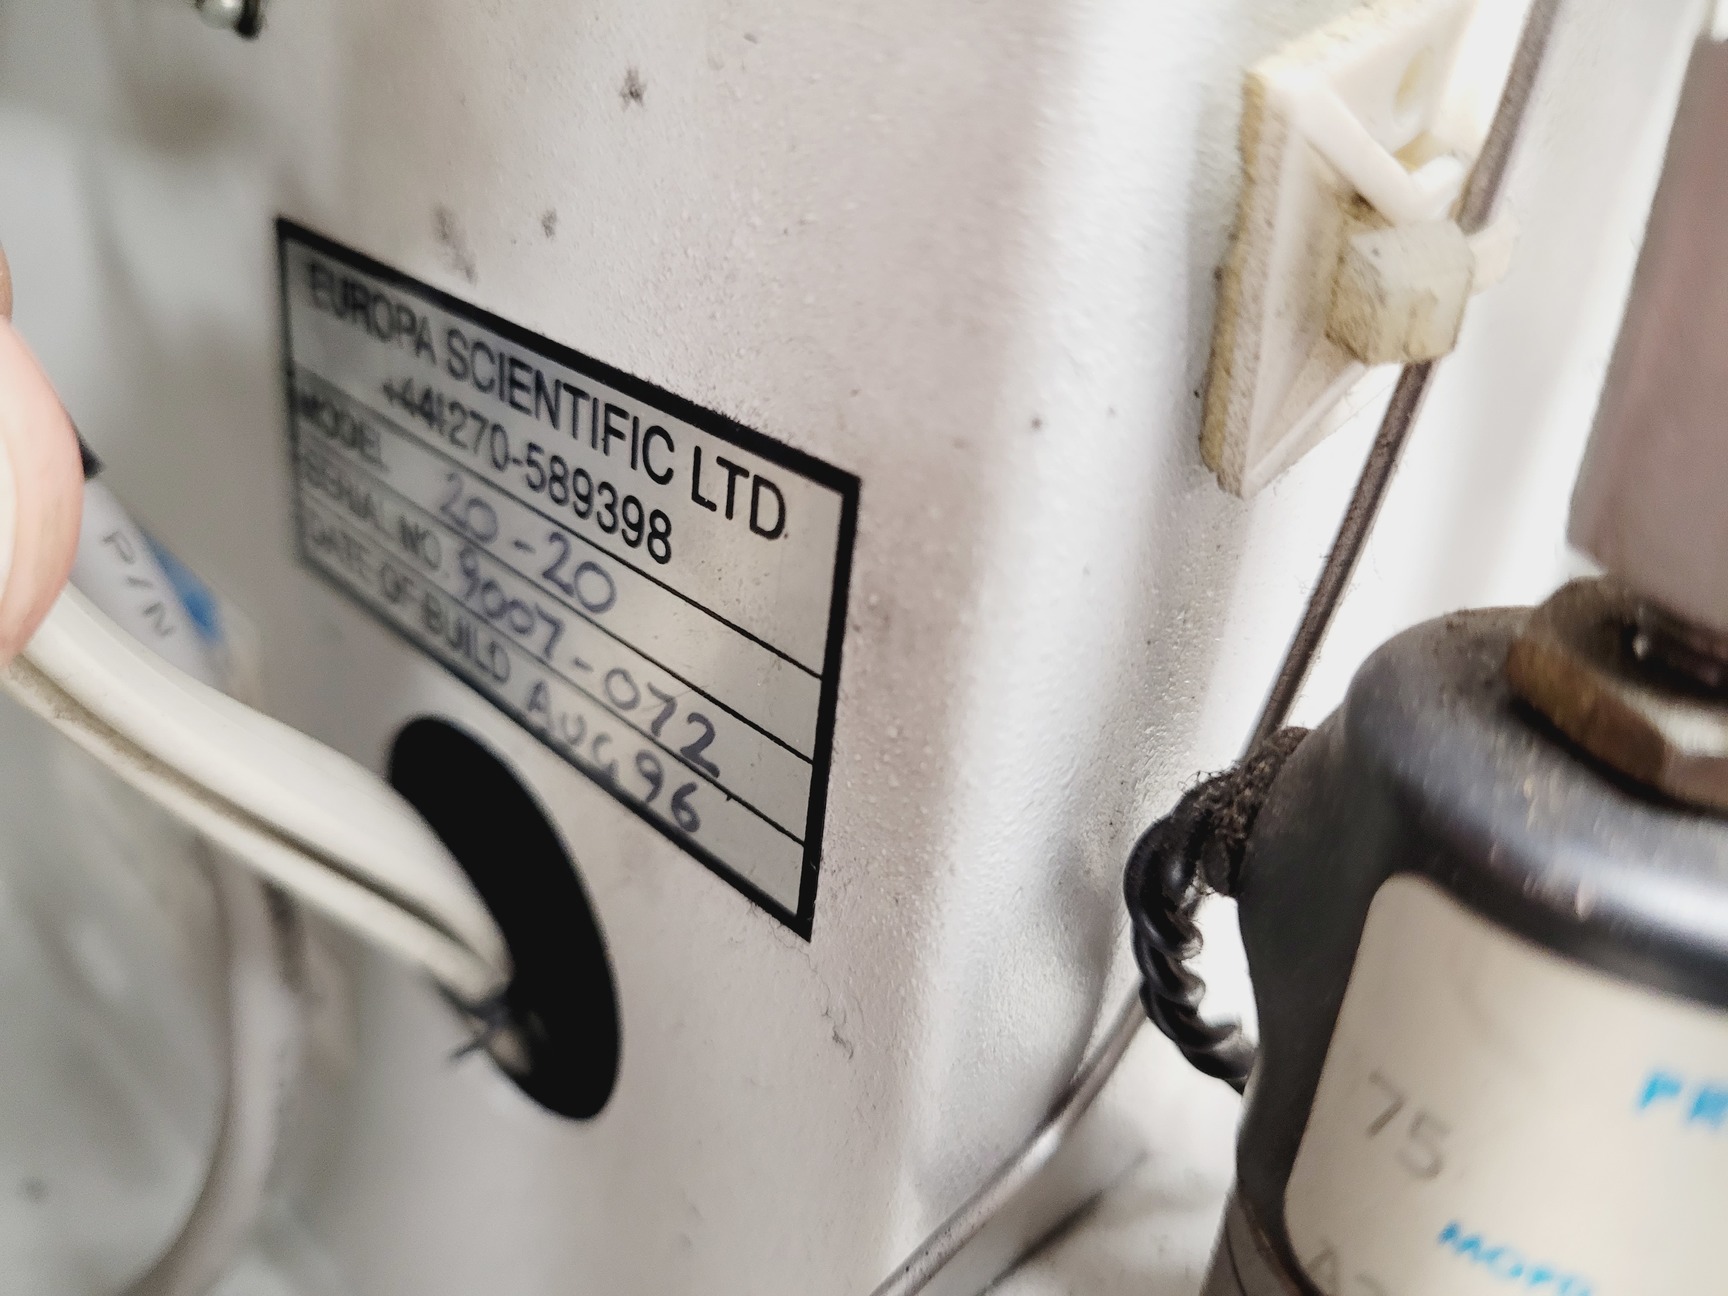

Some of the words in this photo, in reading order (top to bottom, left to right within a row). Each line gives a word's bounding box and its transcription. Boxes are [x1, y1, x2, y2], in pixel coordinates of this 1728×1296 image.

[308, 260, 437, 366] EUROPA
[447, 328, 675, 486] SCIENTIFIC
[382, 378, 672, 565] +441270-589398
